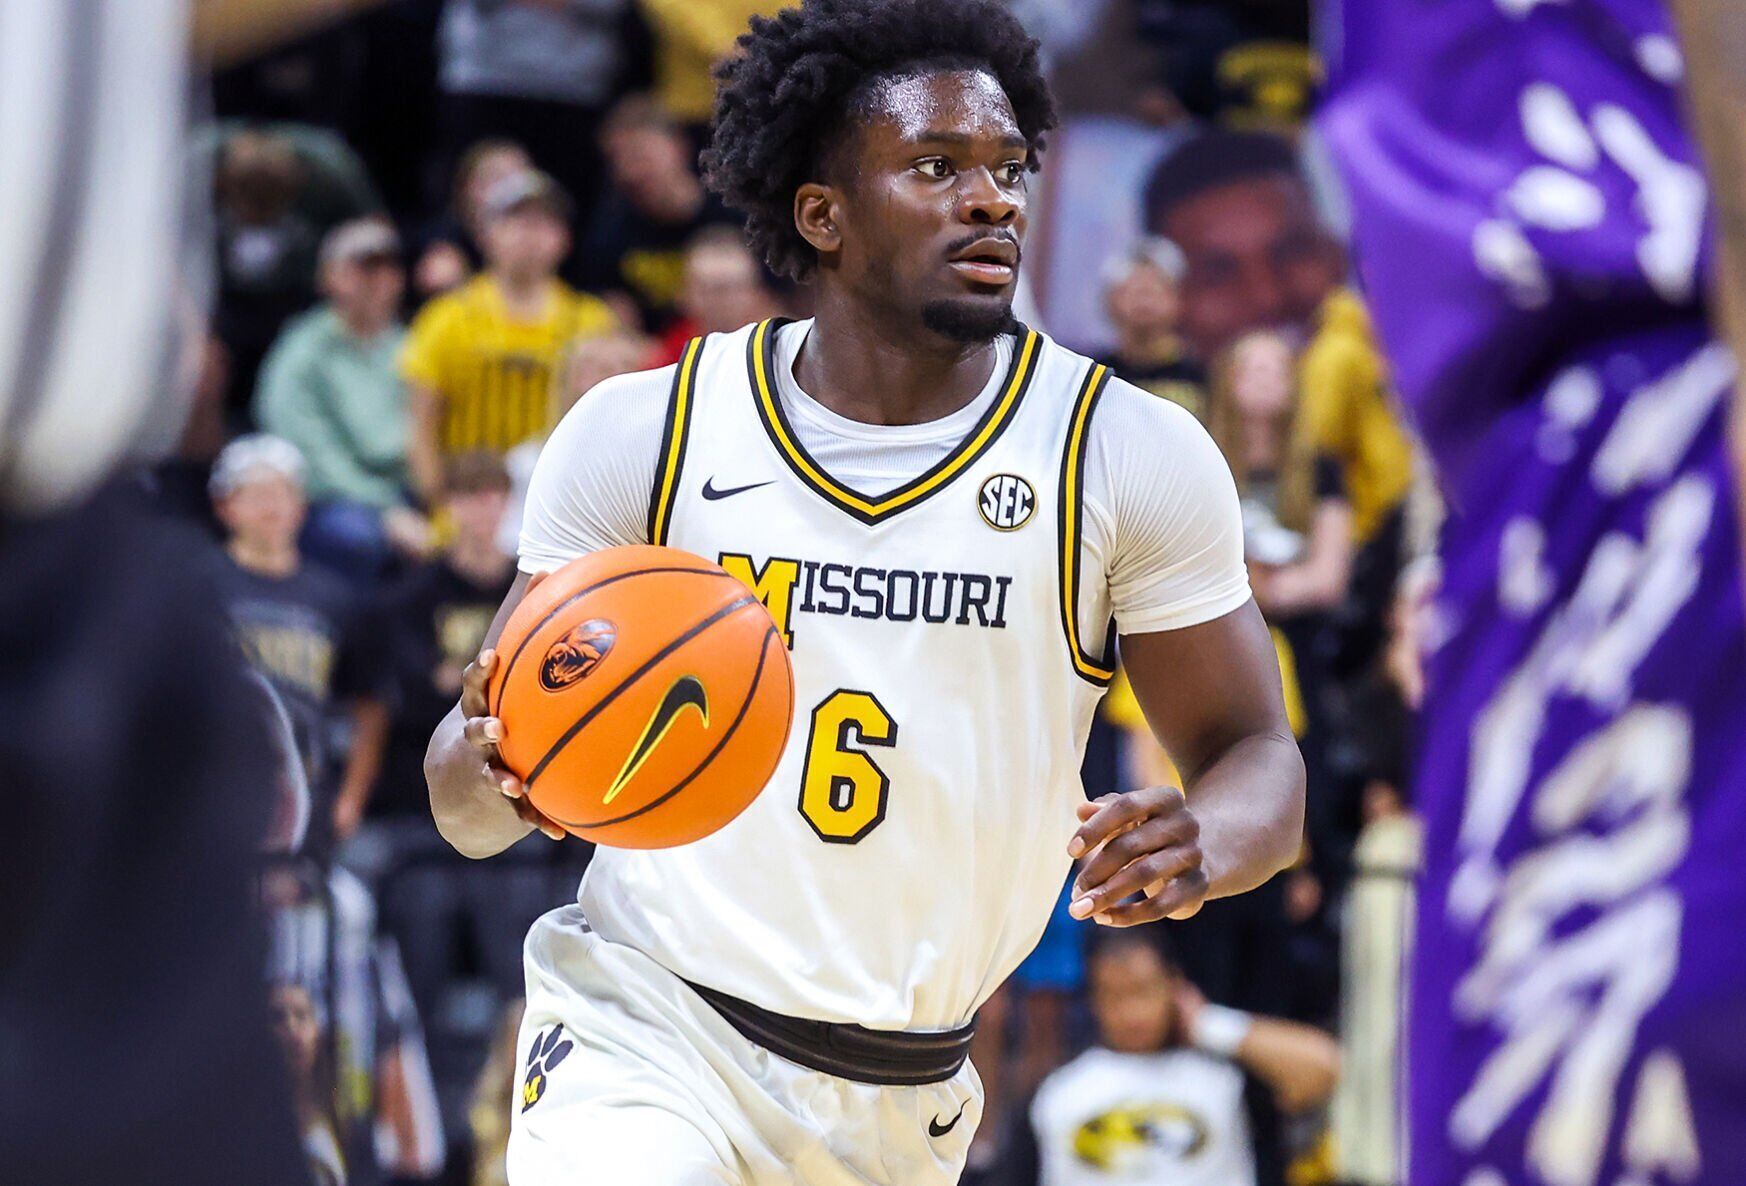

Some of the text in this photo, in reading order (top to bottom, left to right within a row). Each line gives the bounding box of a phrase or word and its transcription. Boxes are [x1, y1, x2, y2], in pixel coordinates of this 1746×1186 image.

[980, 475, 1035, 527] SEC
[718, 551, 1013, 651] MISSOURI
[797, 688, 899, 845] 6
